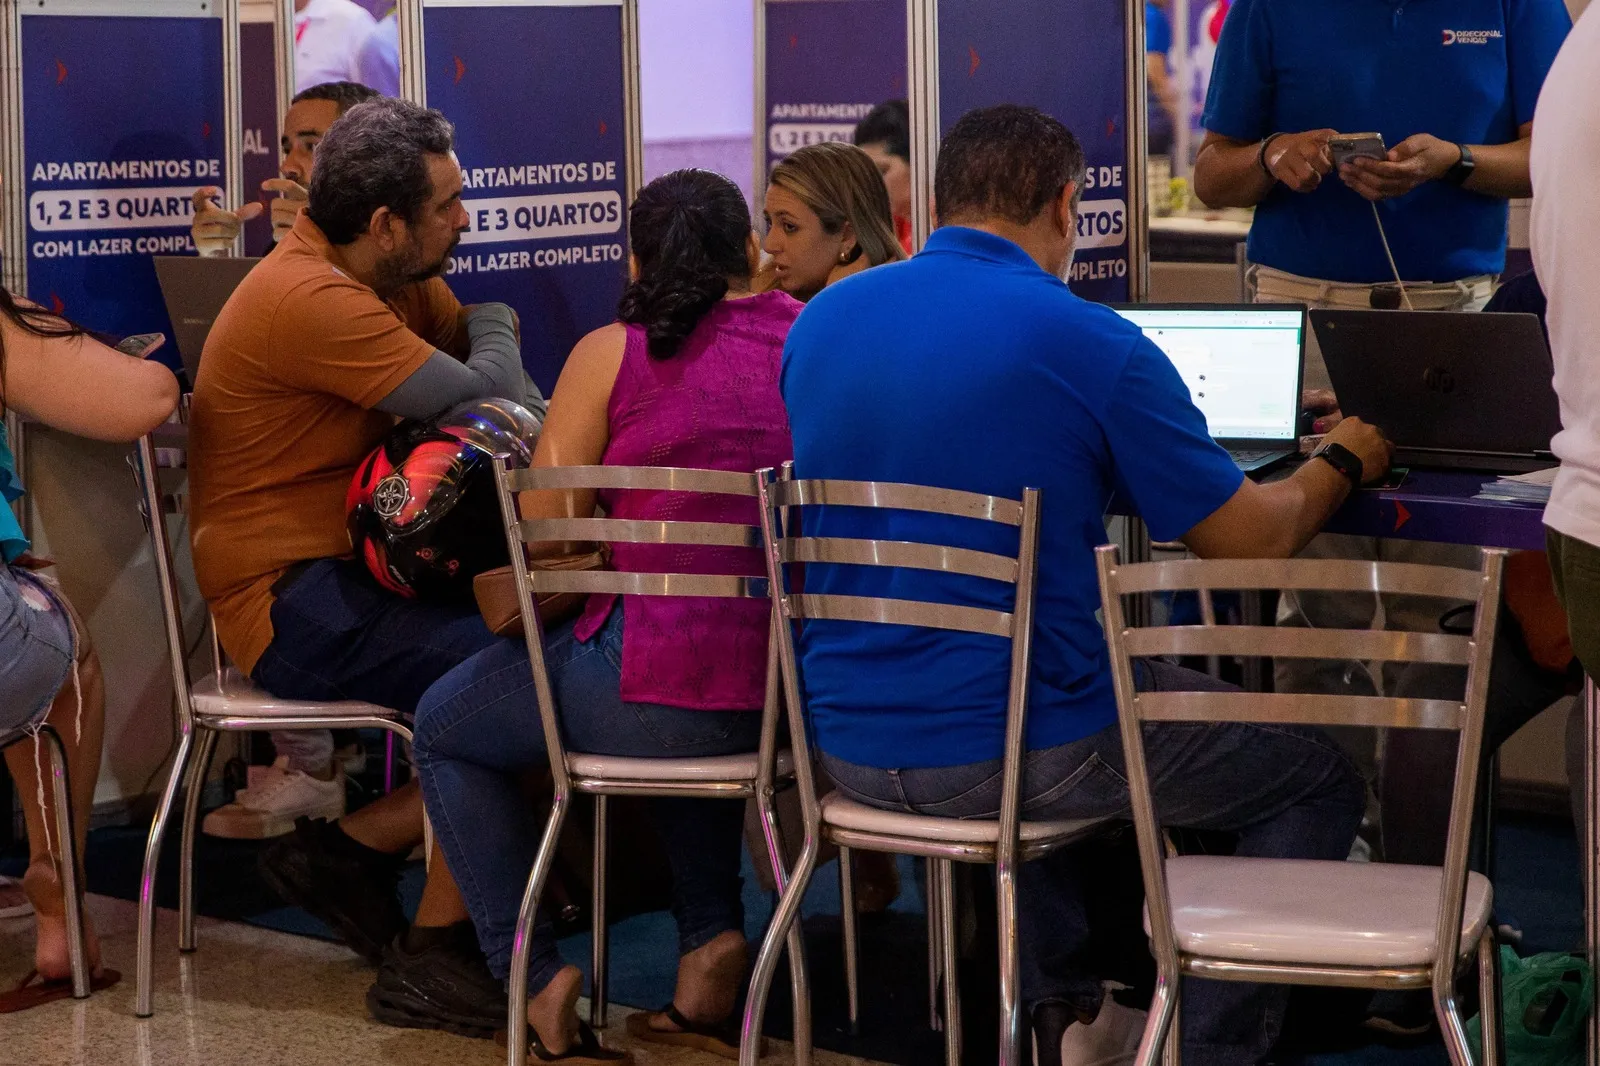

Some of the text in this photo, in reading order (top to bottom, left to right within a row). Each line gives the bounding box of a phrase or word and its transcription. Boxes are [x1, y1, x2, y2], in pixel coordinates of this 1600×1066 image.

[32, 159, 221, 181] APARTAMENTOS DE
[460, 161, 616, 188] ARTAMENTOS DE
[1099, 166, 1122, 188] DE
[36, 195, 221, 225] 1, 2 E 3 QUARTS
[477, 210, 490, 232] E
[495, 208, 509, 231] 3
[514, 200, 618, 231] QUARTOS
[1077, 210, 1123, 237] RTOS
[33, 235, 196, 258] COM LAZER COMPL
[446, 243, 623, 274] OM LAZER COMPLETO
[1069, 258, 1127, 281] MPLETO
